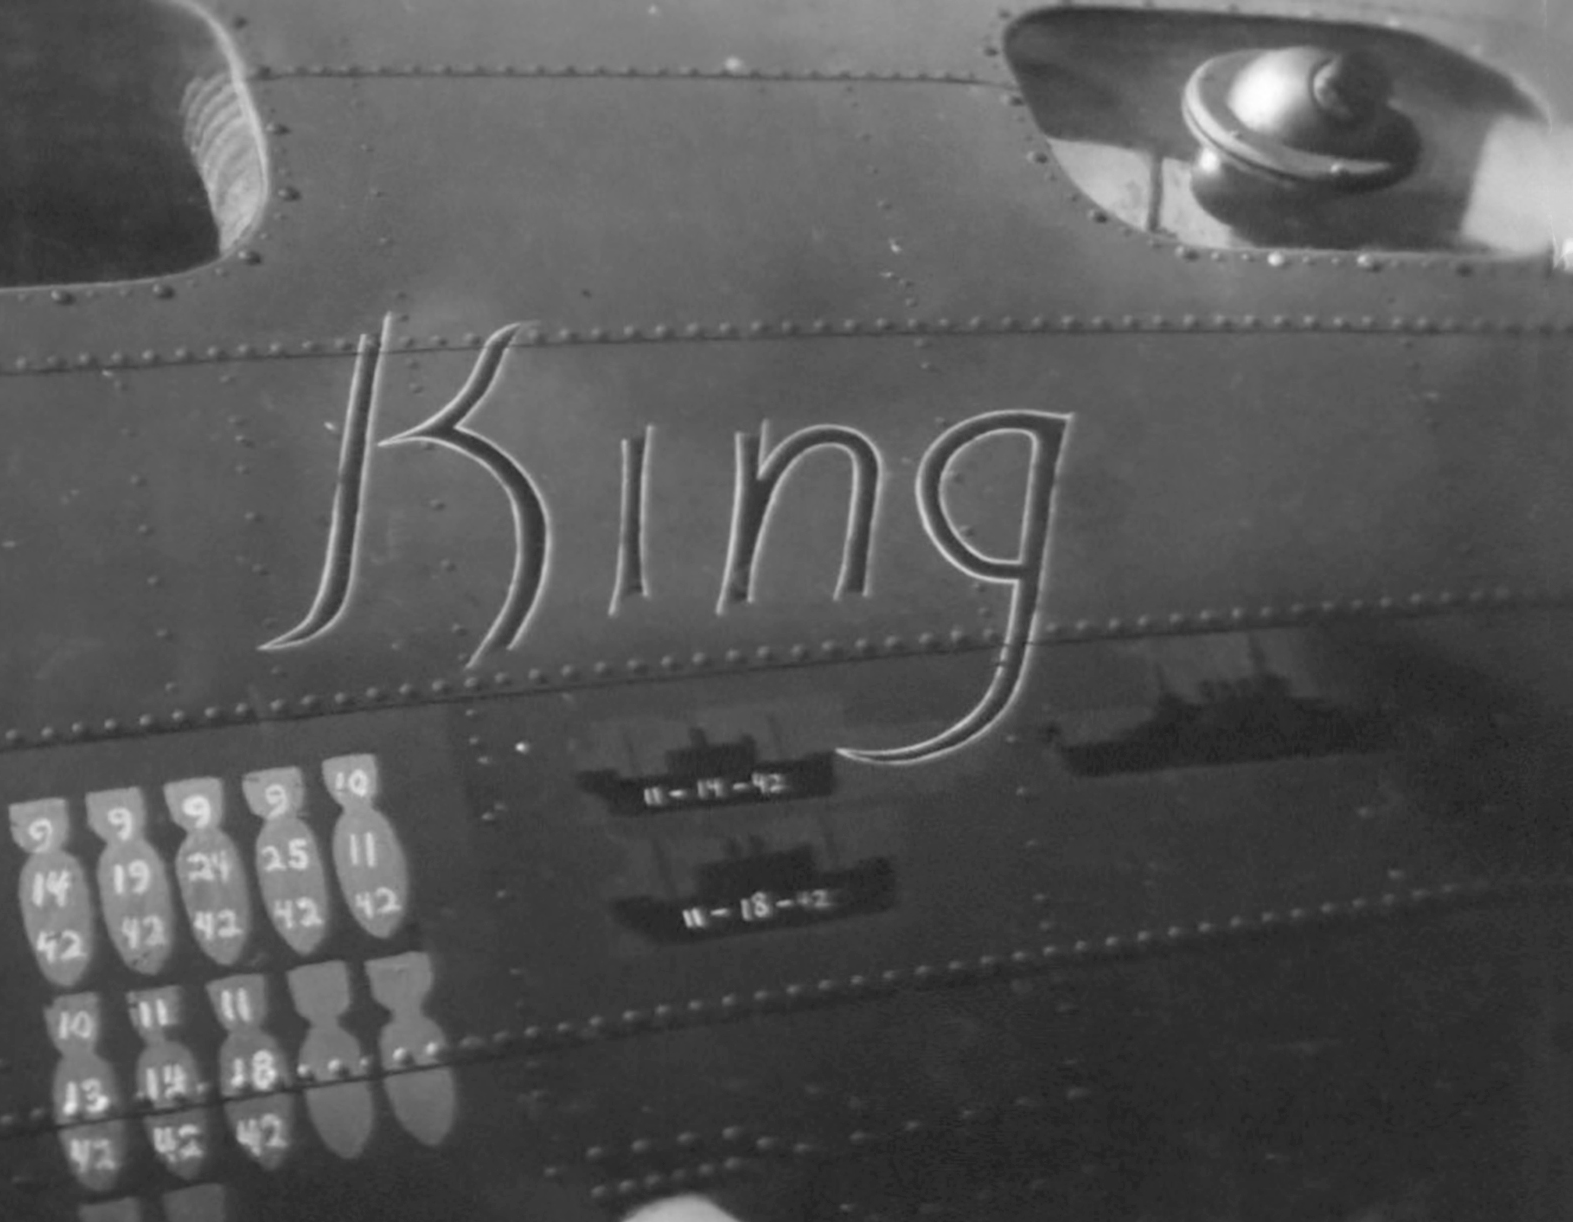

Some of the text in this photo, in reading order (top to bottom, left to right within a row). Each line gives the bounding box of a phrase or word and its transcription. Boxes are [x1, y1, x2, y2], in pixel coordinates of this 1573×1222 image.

[258, 311, 1078, 768] King
[265, 783, 291, 818] 9
[333, 769, 370, 797] 10
[106, 807, 134, 840] 9
[181, 795, 212, 830] 9
[27, 818, 55, 853] 9
[349, 832, 378, 868] 11
[261, 838, 311, 873] 25
[112, 859, 151, 895] 19
[272, 895, 324, 930] 42
[354, 886, 402, 919] 42
[122, 915, 168, 950] 42
[193, 909, 244, 943] 42
[36, 929, 87, 964] 42
[138, 998, 169, 1028] 11
[221, 987, 253, 1023] 11
[57, 1009, 94, 1040] 10
[230, 1050, 277, 1090] 18
[63, 1078, 109, 1116] 13
[235, 1112, 290, 1157] 42
